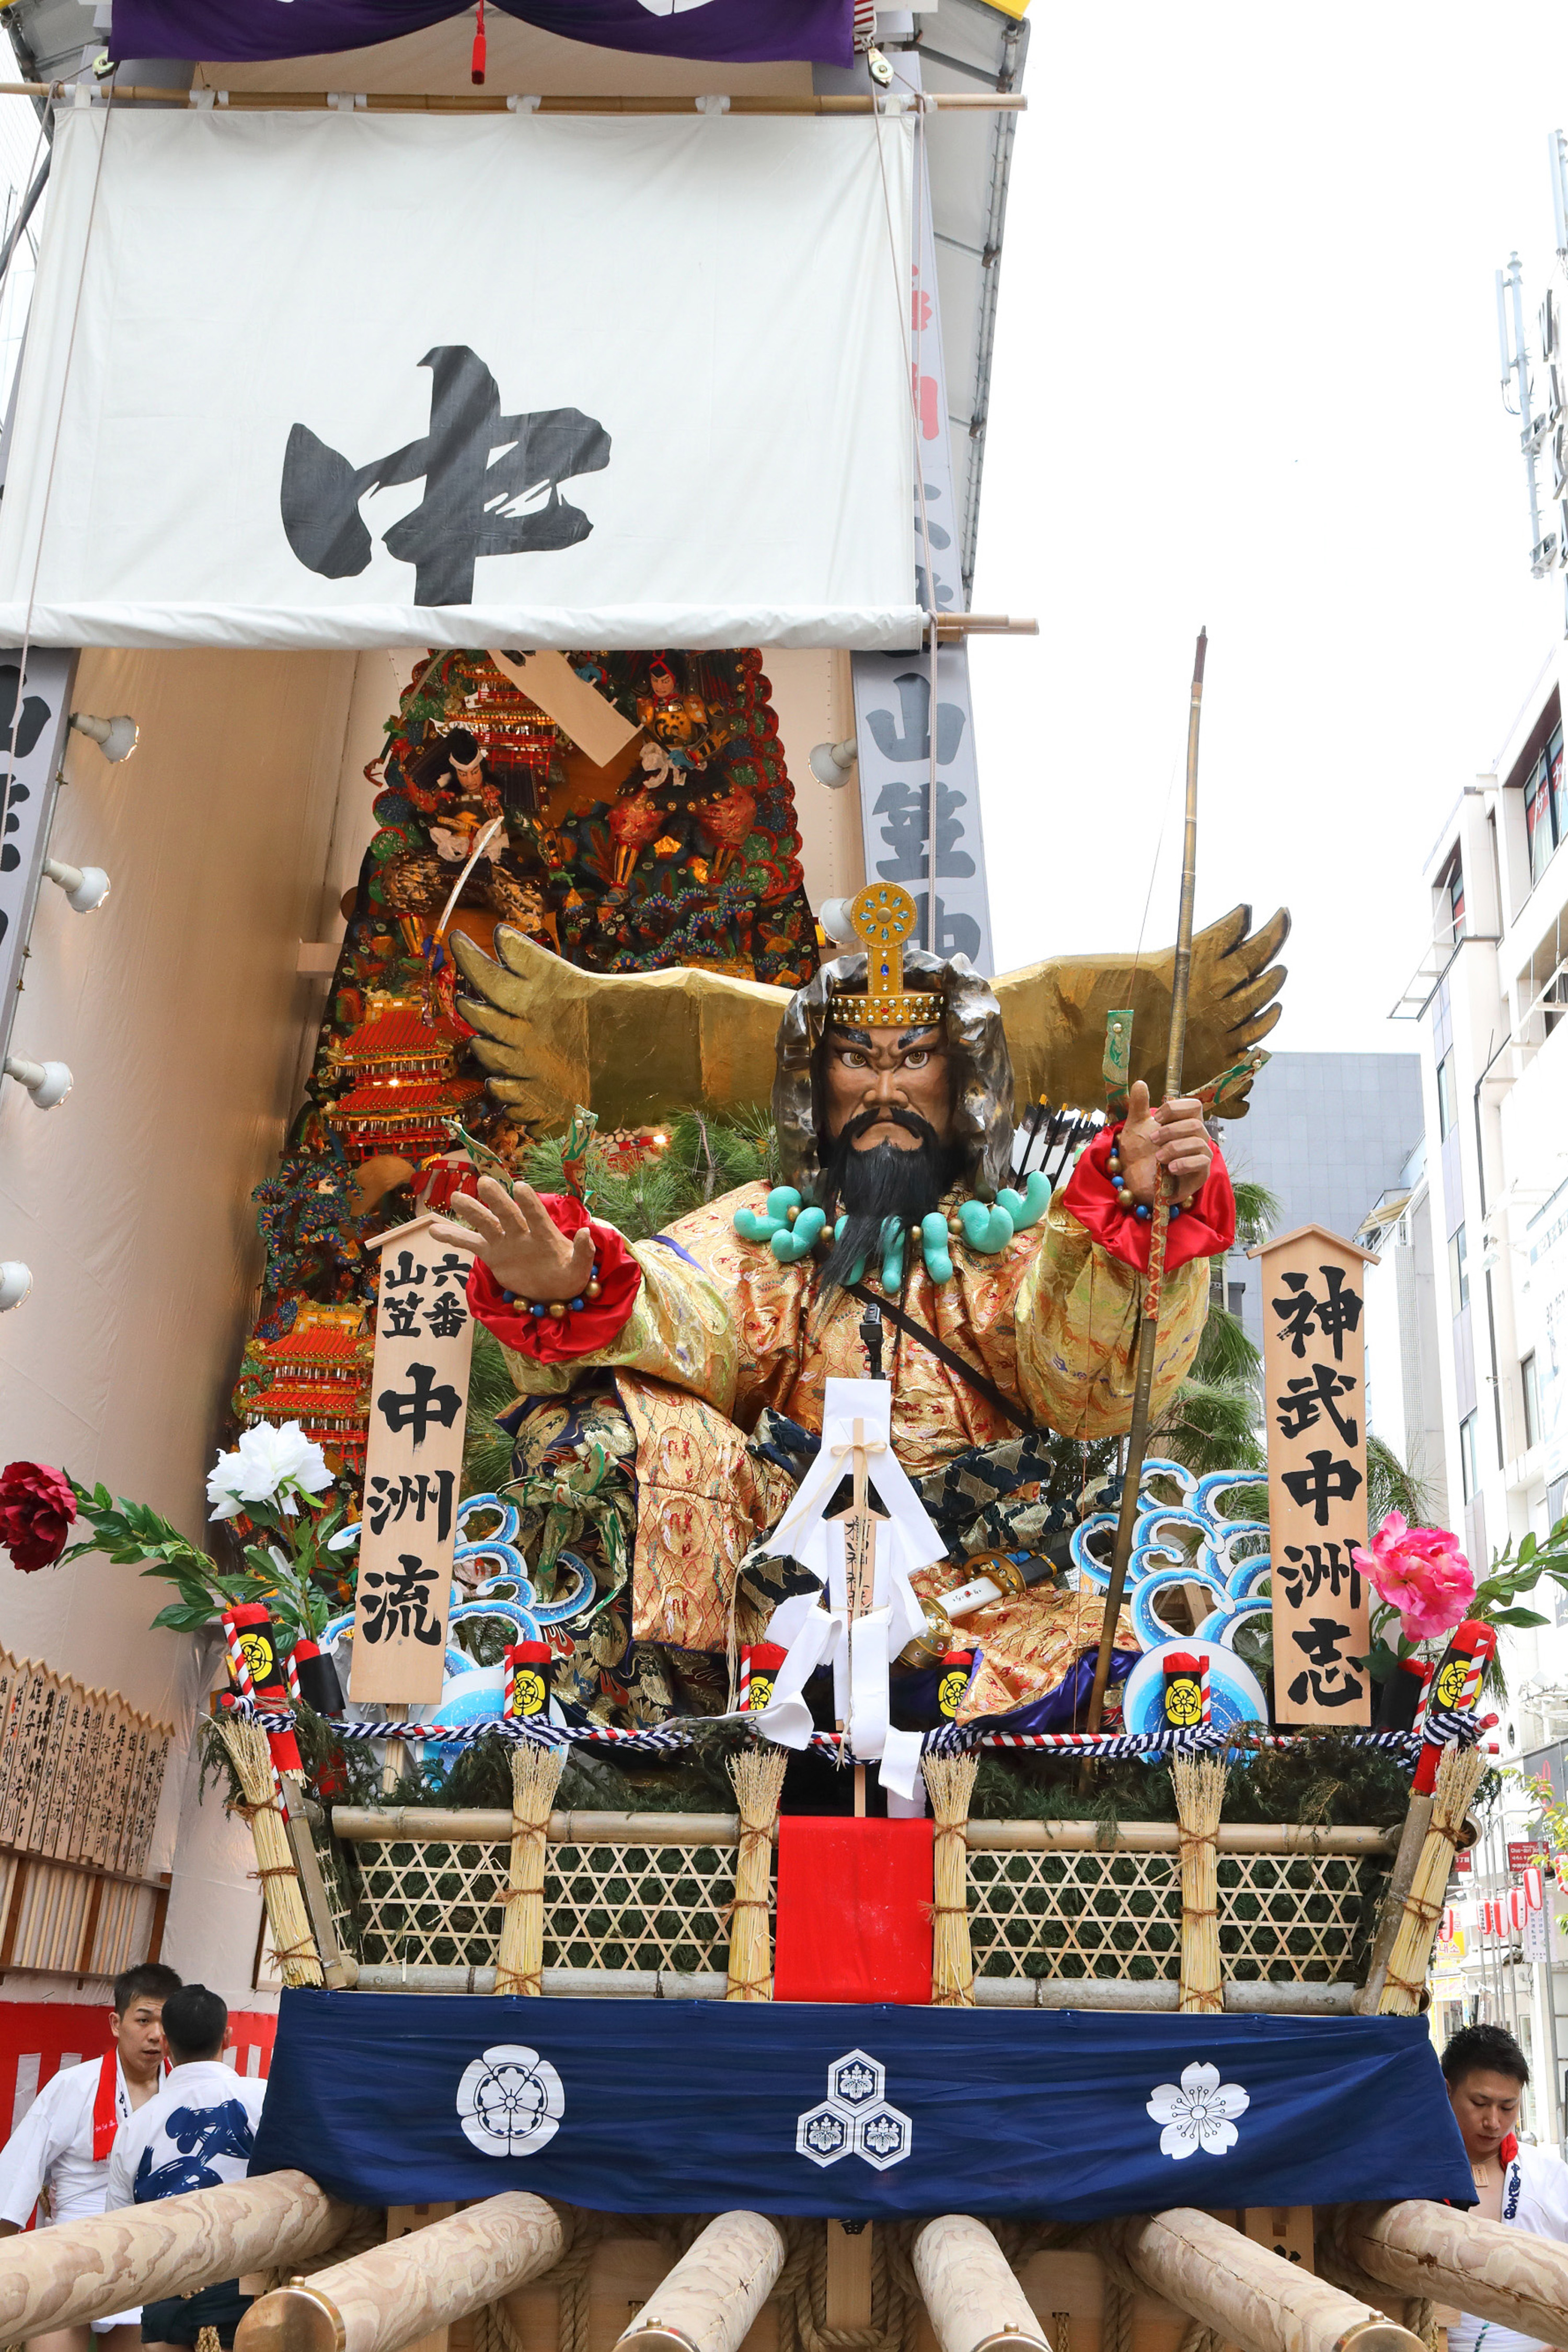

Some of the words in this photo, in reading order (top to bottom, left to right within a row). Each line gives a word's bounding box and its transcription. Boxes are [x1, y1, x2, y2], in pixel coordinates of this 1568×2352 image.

[360, 1362, 463, 1645] 中洲流
[1271, 1265, 1365, 1707] 神武中洲志
